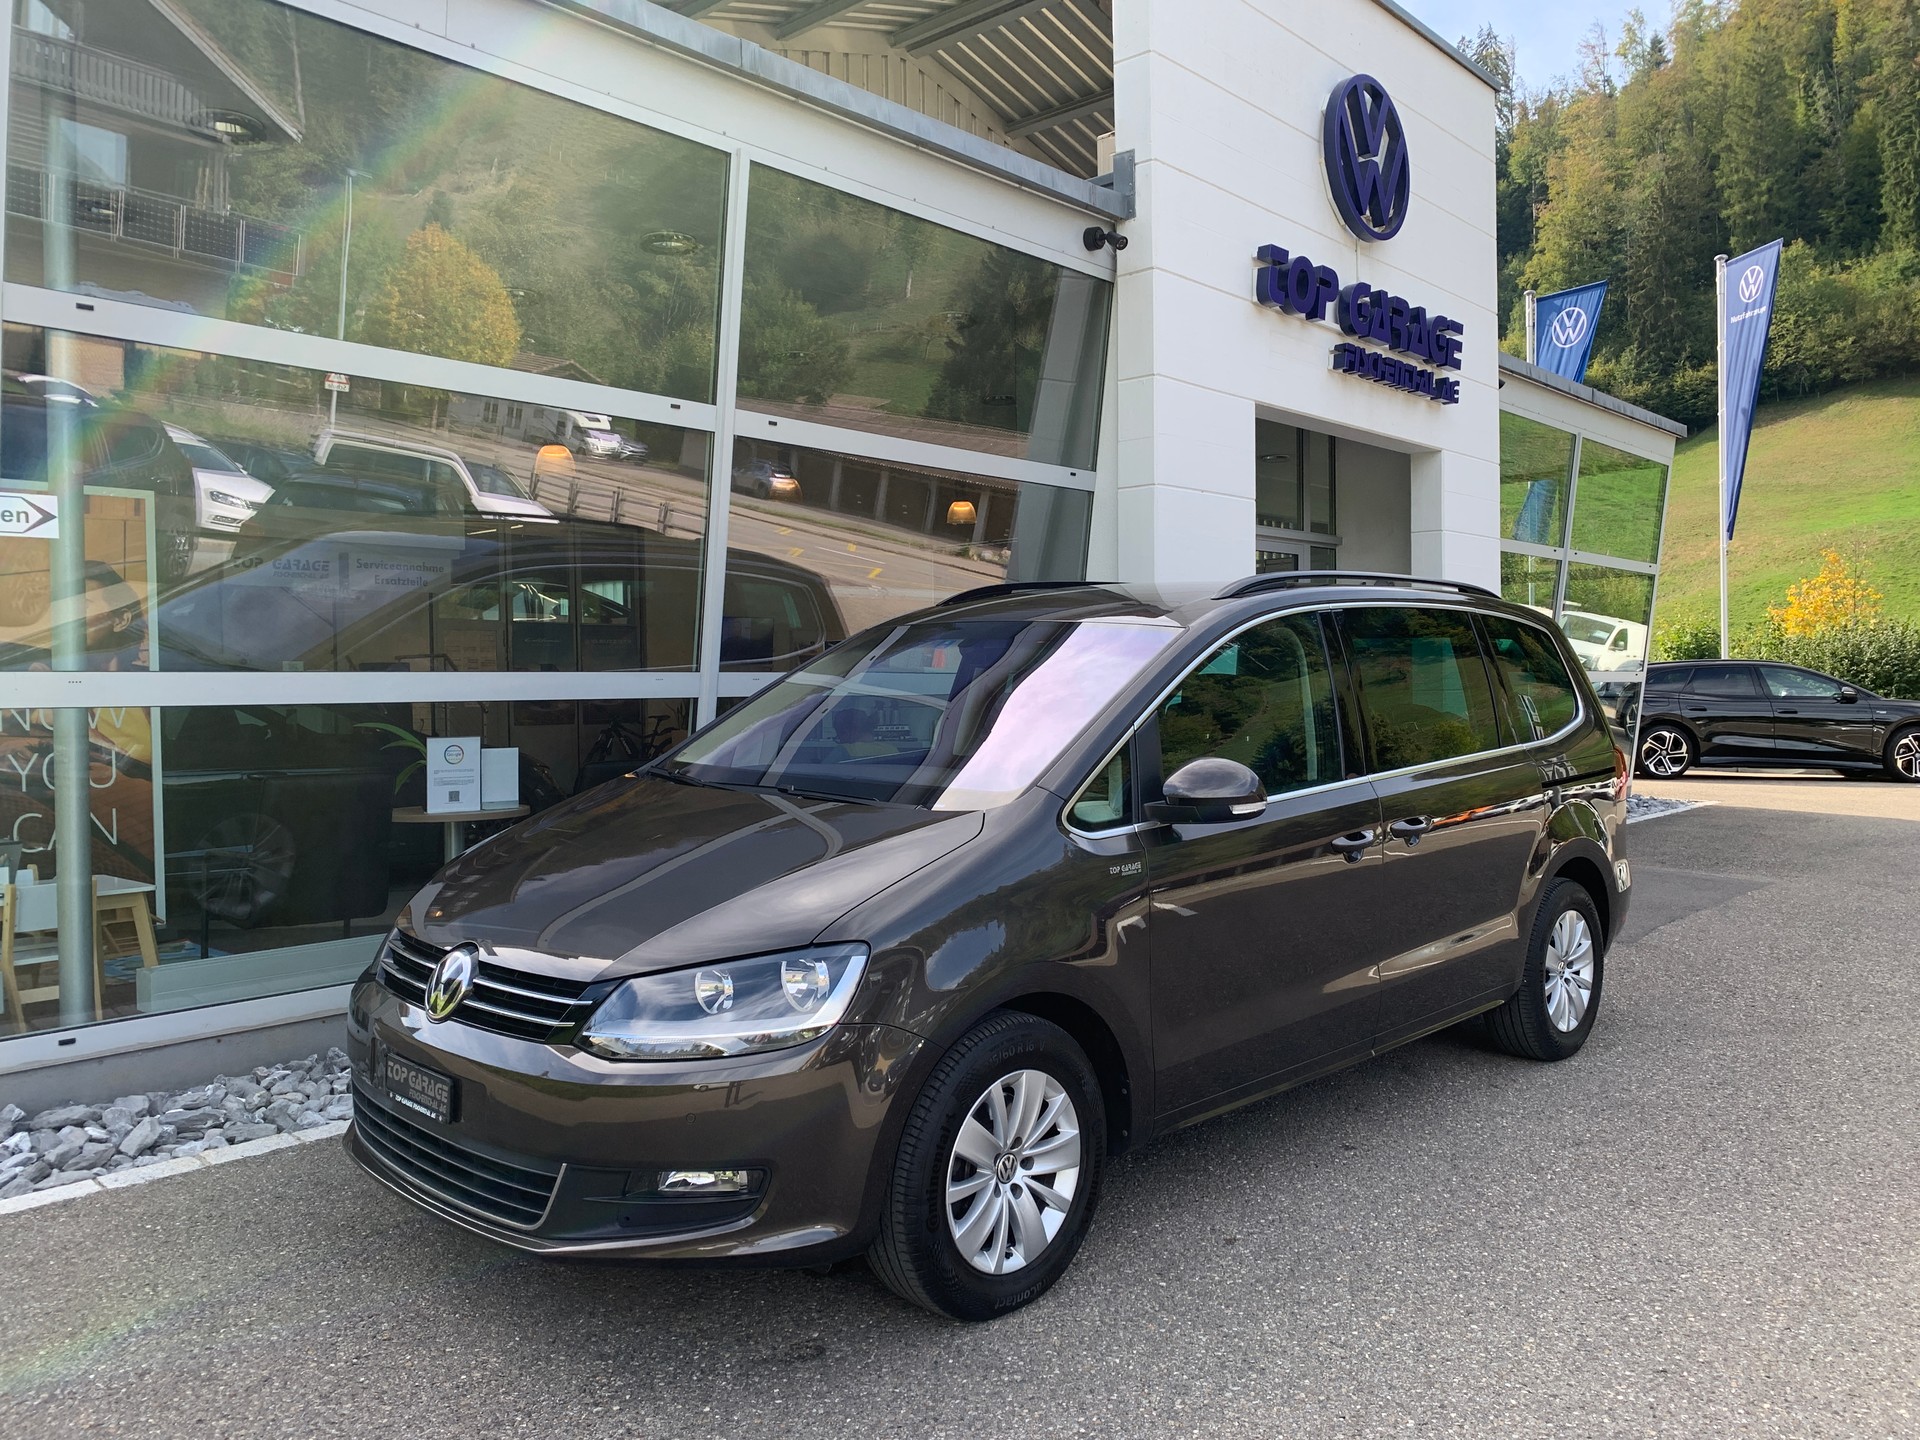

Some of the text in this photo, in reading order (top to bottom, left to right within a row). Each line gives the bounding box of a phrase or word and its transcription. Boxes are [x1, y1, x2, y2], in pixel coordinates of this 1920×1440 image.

[1256, 243, 1464, 372] TOP GARAGE
[272, 559, 330, 572] GARAGE
[356, 558, 445, 574] Serviceannahme
[374, 574, 429, 587] Ersatzteile
[13, 807, 118, 853] CN
[1120, 861, 1142, 873] GARAGE
[387, 1060, 449, 1103] TOP GARAGE
